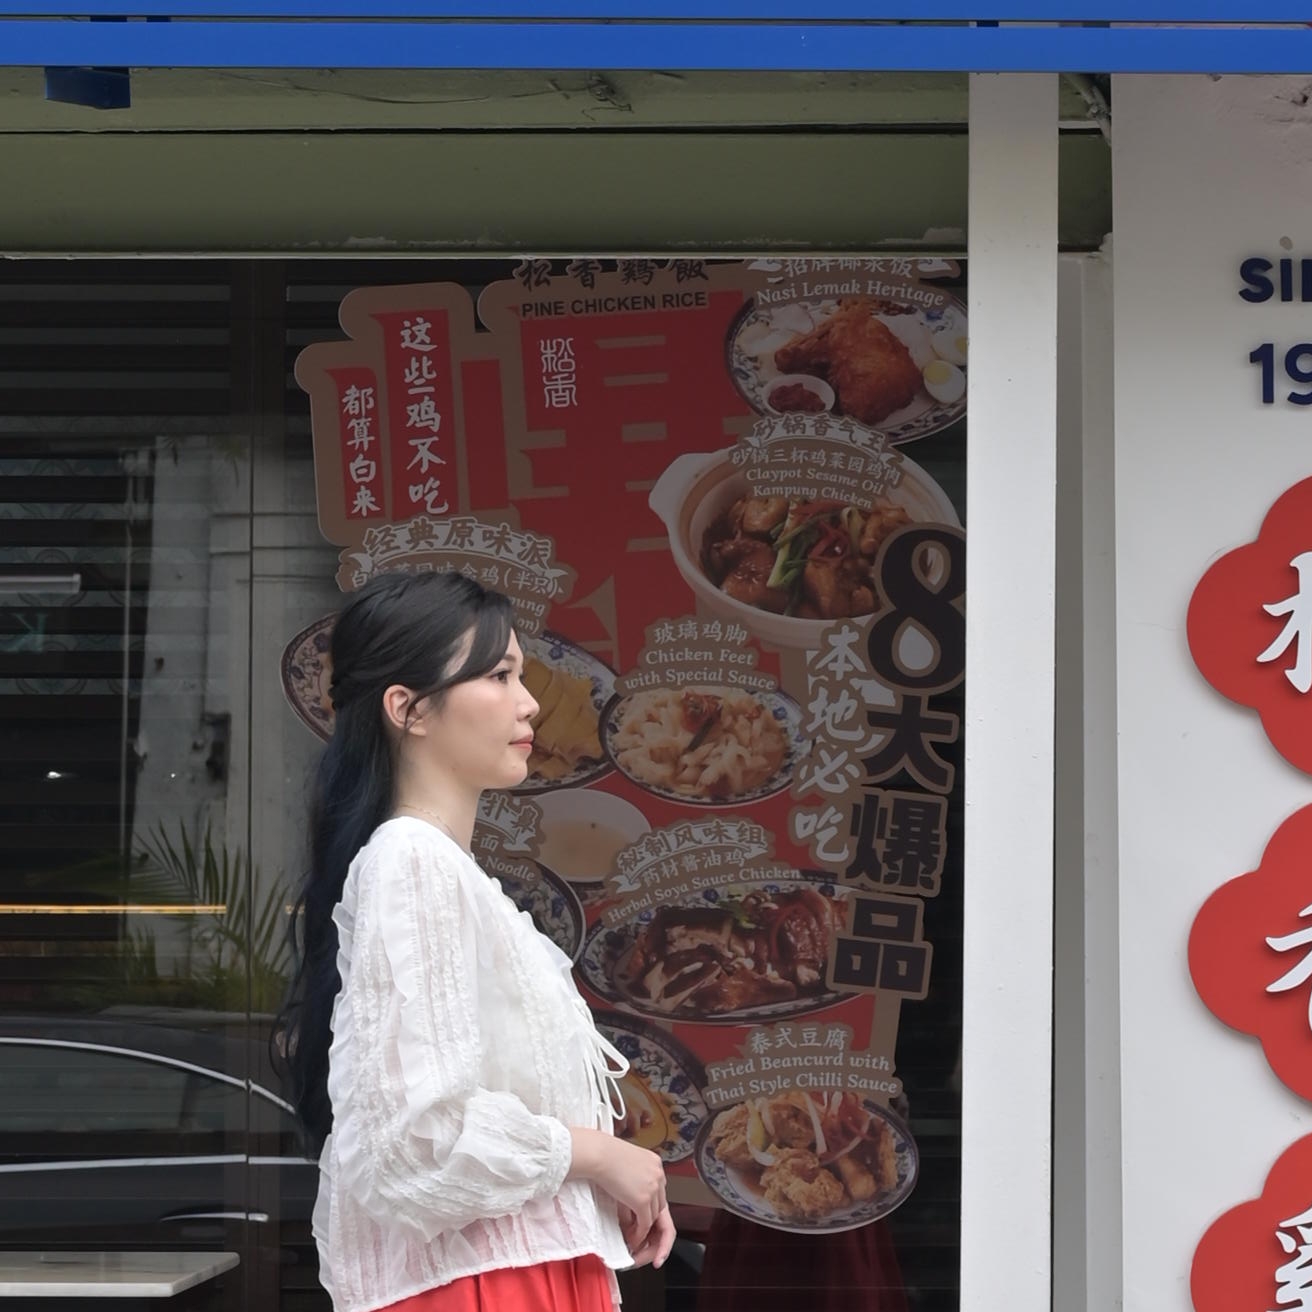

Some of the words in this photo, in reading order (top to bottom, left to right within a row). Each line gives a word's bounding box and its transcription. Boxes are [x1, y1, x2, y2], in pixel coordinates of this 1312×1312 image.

[521, 301, 566, 317] PINE
[570, 295, 656, 314] CHICKEN
[662, 291, 707, 308] RICE
[756, 283, 798, 307] Nasi
[802, 279, 861, 297] Lemak
[866, 280, 945, 309] Heritage
[399, 316, 449, 515] 这些鸡不吃
[752, 414, 885, 454] 砂锅香气王
[340, 384, 381, 518] 都算白来
[746, 467, 803, 482] Claypot
[806, 468, 859, 487] Sesame
[862, 479, 884, 495] Oil
[753, 484, 818, 500] Kampung
[821, 486, 872, 510] Chicken
[363, 517, 553, 570] 经典原味派
[653, 619, 748, 646] 玻璃鸡脚
[645, 647, 714, 665] Chicken
[719, 649, 754, 666] Feet
[624, 671, 661, 691] with
[665, 666, 723, 686] Special
[727, 669, 776, 691] Sauce
[793, 625, 871, 864] 本地必吃
[617, 819, 766, 876] 秘制风味组
[485, 855, 536, 881] Noodle
[607, 894, 653, 923] Herbal
[654, 883, 690, 901] Soya
[691, 873, 736, 890] Sauce
[738, 865, 802, 881] Chicken
[750, 1027, 849, 1054] 泰式豆腐
[709, 1058, 755, 1082] Fried
[760, 1052, 845, 1073] Beancurd
[850, 1054, 890, 1071] with
[705, 1085, 746, 1106] Thai
[749, 1075, 792, 1095] Style
[795, 1071, 844, 1088] Chilli
[847, 1073, 898, 1094] Sauce
